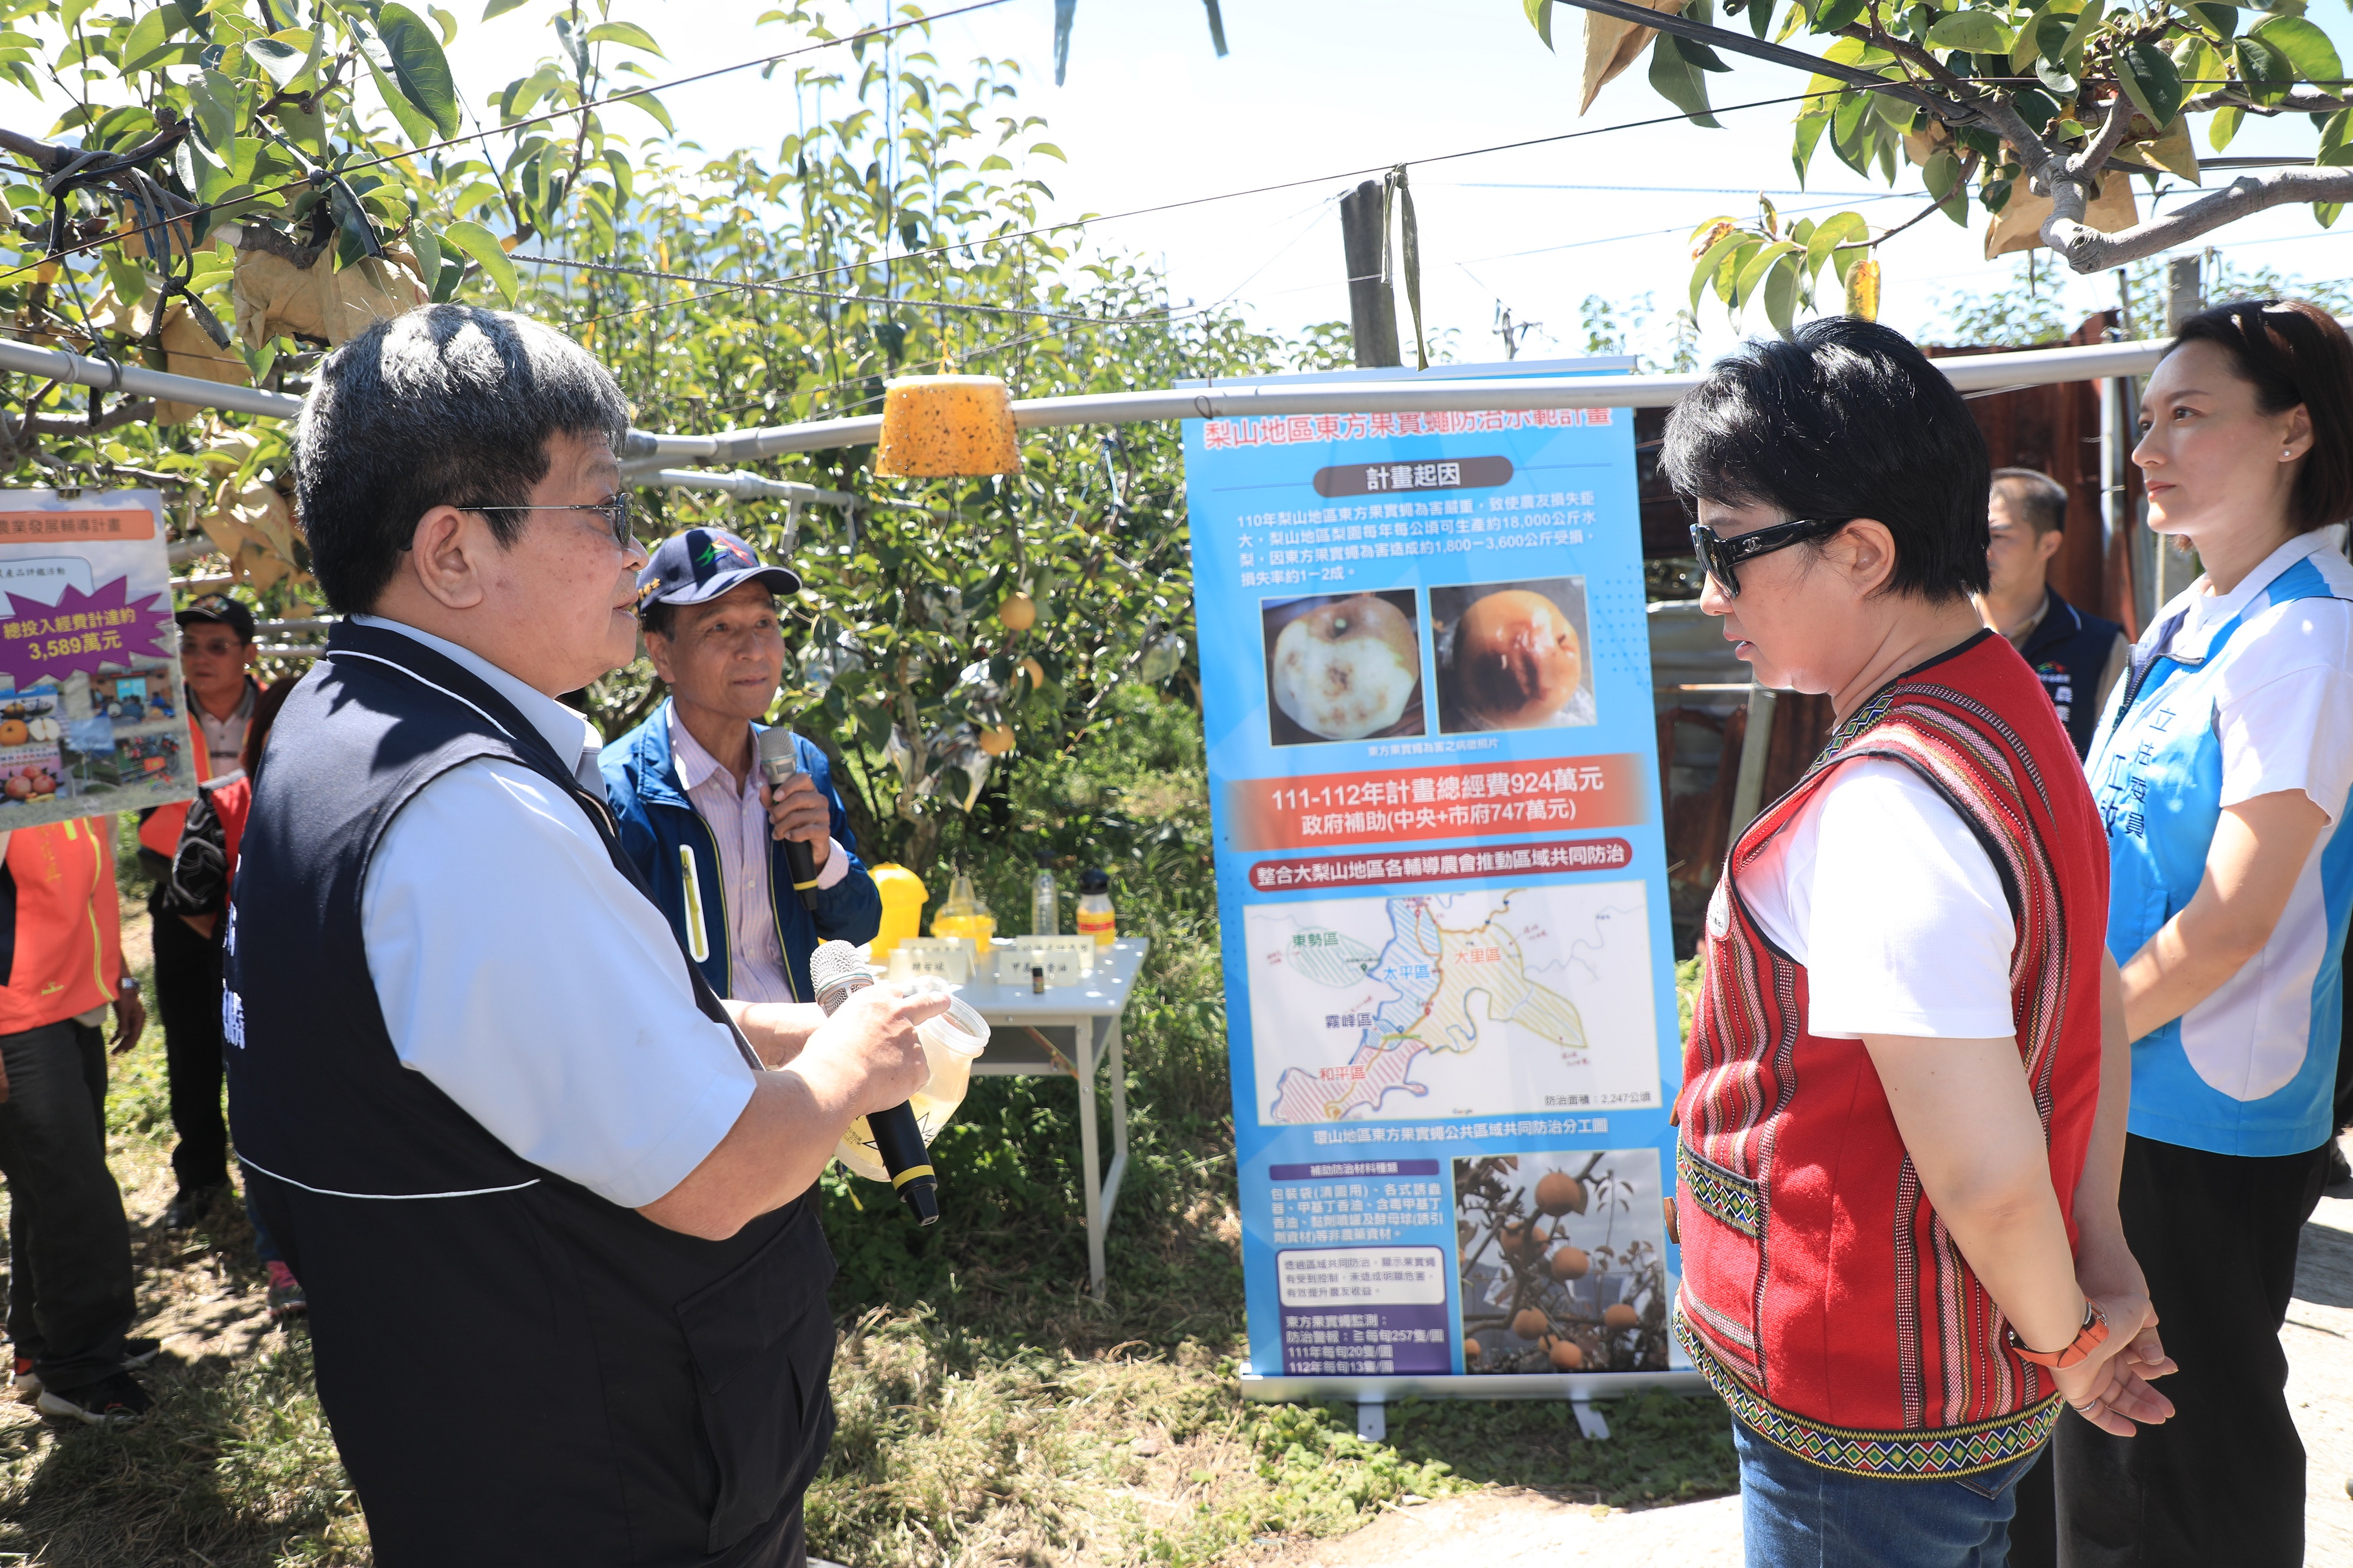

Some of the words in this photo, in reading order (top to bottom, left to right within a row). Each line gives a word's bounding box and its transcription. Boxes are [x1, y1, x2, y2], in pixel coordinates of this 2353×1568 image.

[1365, 462, 1461, 491] 計畫起因
[2, 607, 136, 640] 總投入經費計達約
[29, 630, 122, 662] 3,589萬元
[1272, 766, 1604, 810] 111-112年計畫總經費924萬元
[1301, 798, 1577, 836] 政府補助(中央+市府747萬元)
[1257, 843, 1625, 886] 整合大梨山地區各輔導農會推動區域共同防治
[1292, 931, 1339, 949] 東勢區
[1454, 946, 1502, 965] 大里區
[1384, 964, 1431, 982] 太平區
[1325, 1012, 1374, 1030] 霧峰區
[1319, 1065, 1367, 1083] 和平區
[1313, 1117, 1608, 1146] 環山地區東方果實蠅公共區域共同防治分工圖
[1310, 1161, 1399, 1177] 補助防治材料種類
